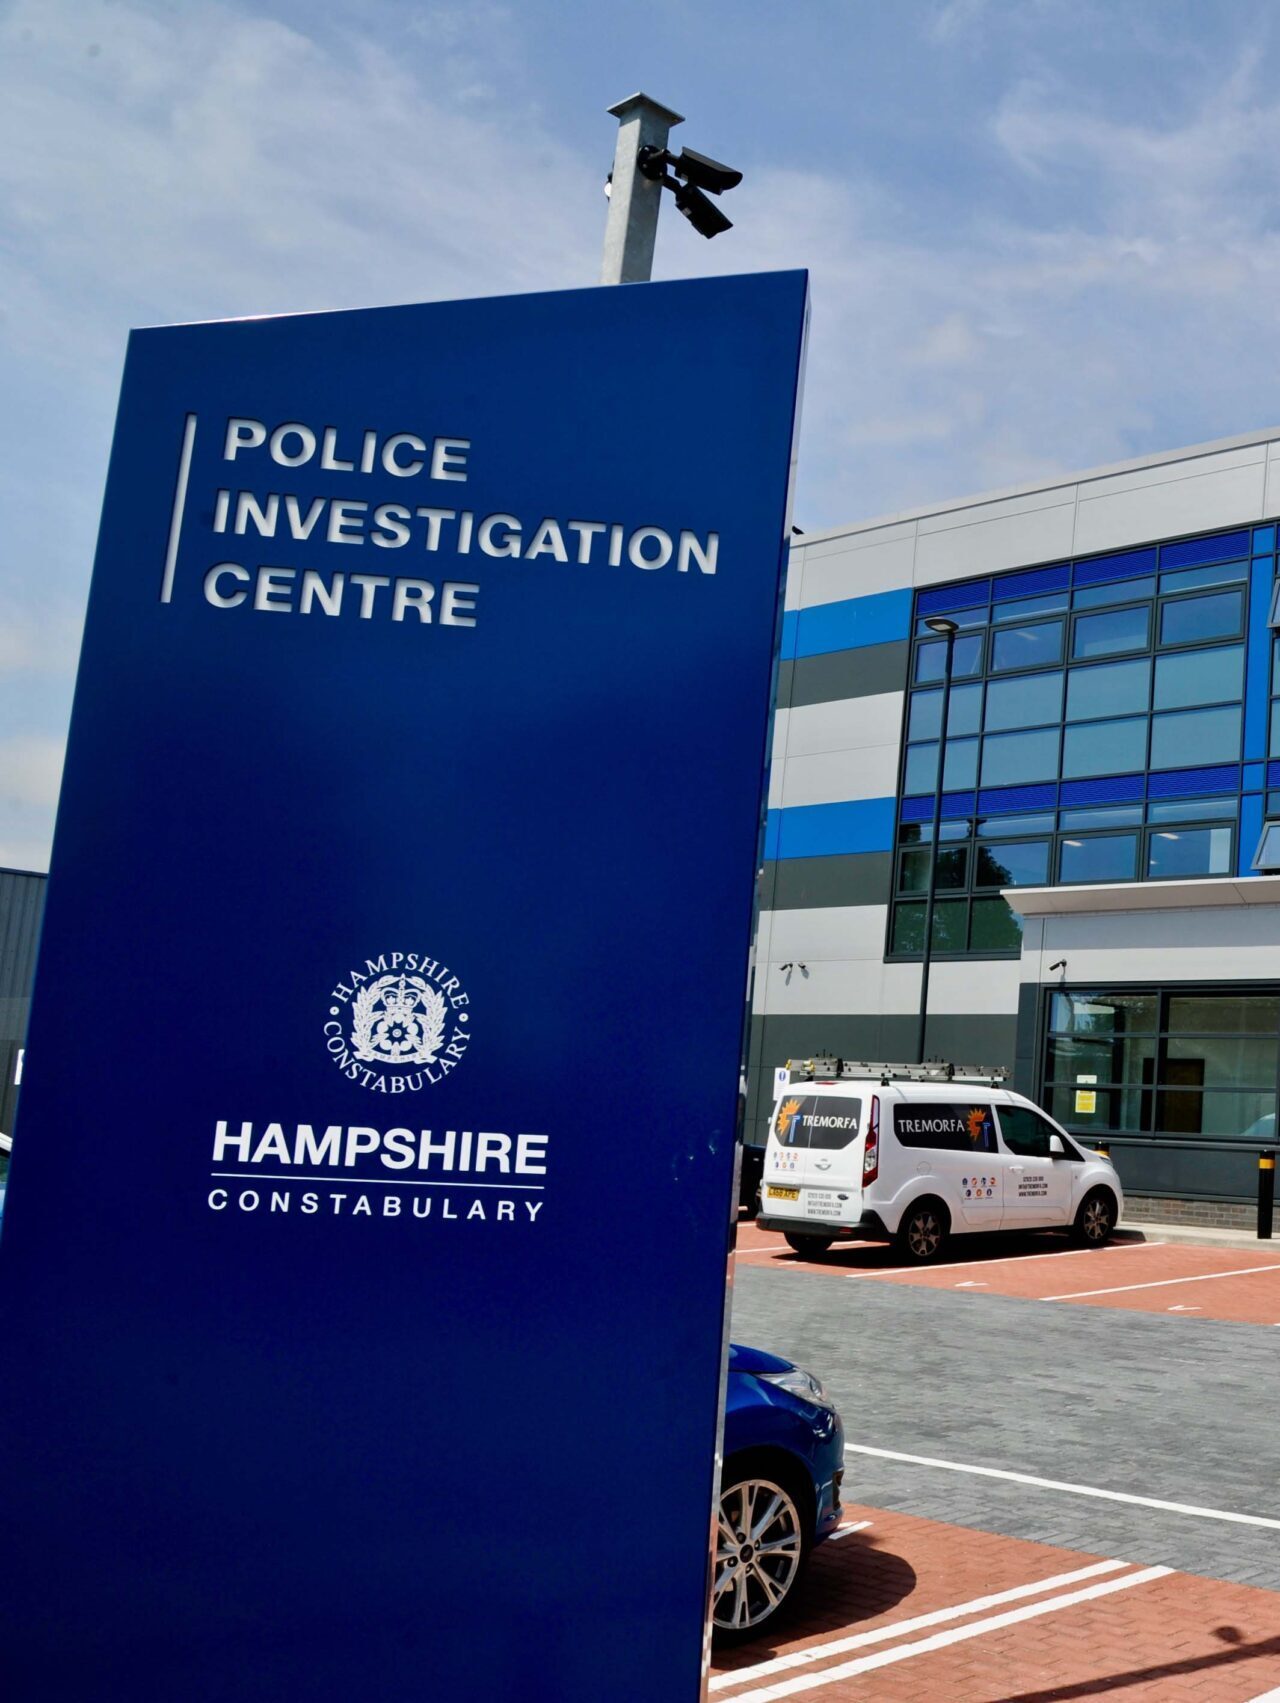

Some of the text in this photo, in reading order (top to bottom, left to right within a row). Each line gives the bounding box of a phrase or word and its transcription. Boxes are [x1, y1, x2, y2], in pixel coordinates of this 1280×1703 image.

[224, 419, 471, 482] POLICE
[213, 491, 720, 576] INVESTIGATION
[203, 563, 480, 629] CENTRE
[331, 952, 470, 1009] HAMPSHIRE
[323, 1021, 471, 1094] CONSTABULARY
[211, 1120, 549, 1175] HAMPSHIRE
[802, 1114, 858, 1130] TREMORFA
[898, 1119, 966, 1133] TREMORFA
[207, 1188, 544, 1222] CONSTABULARY
